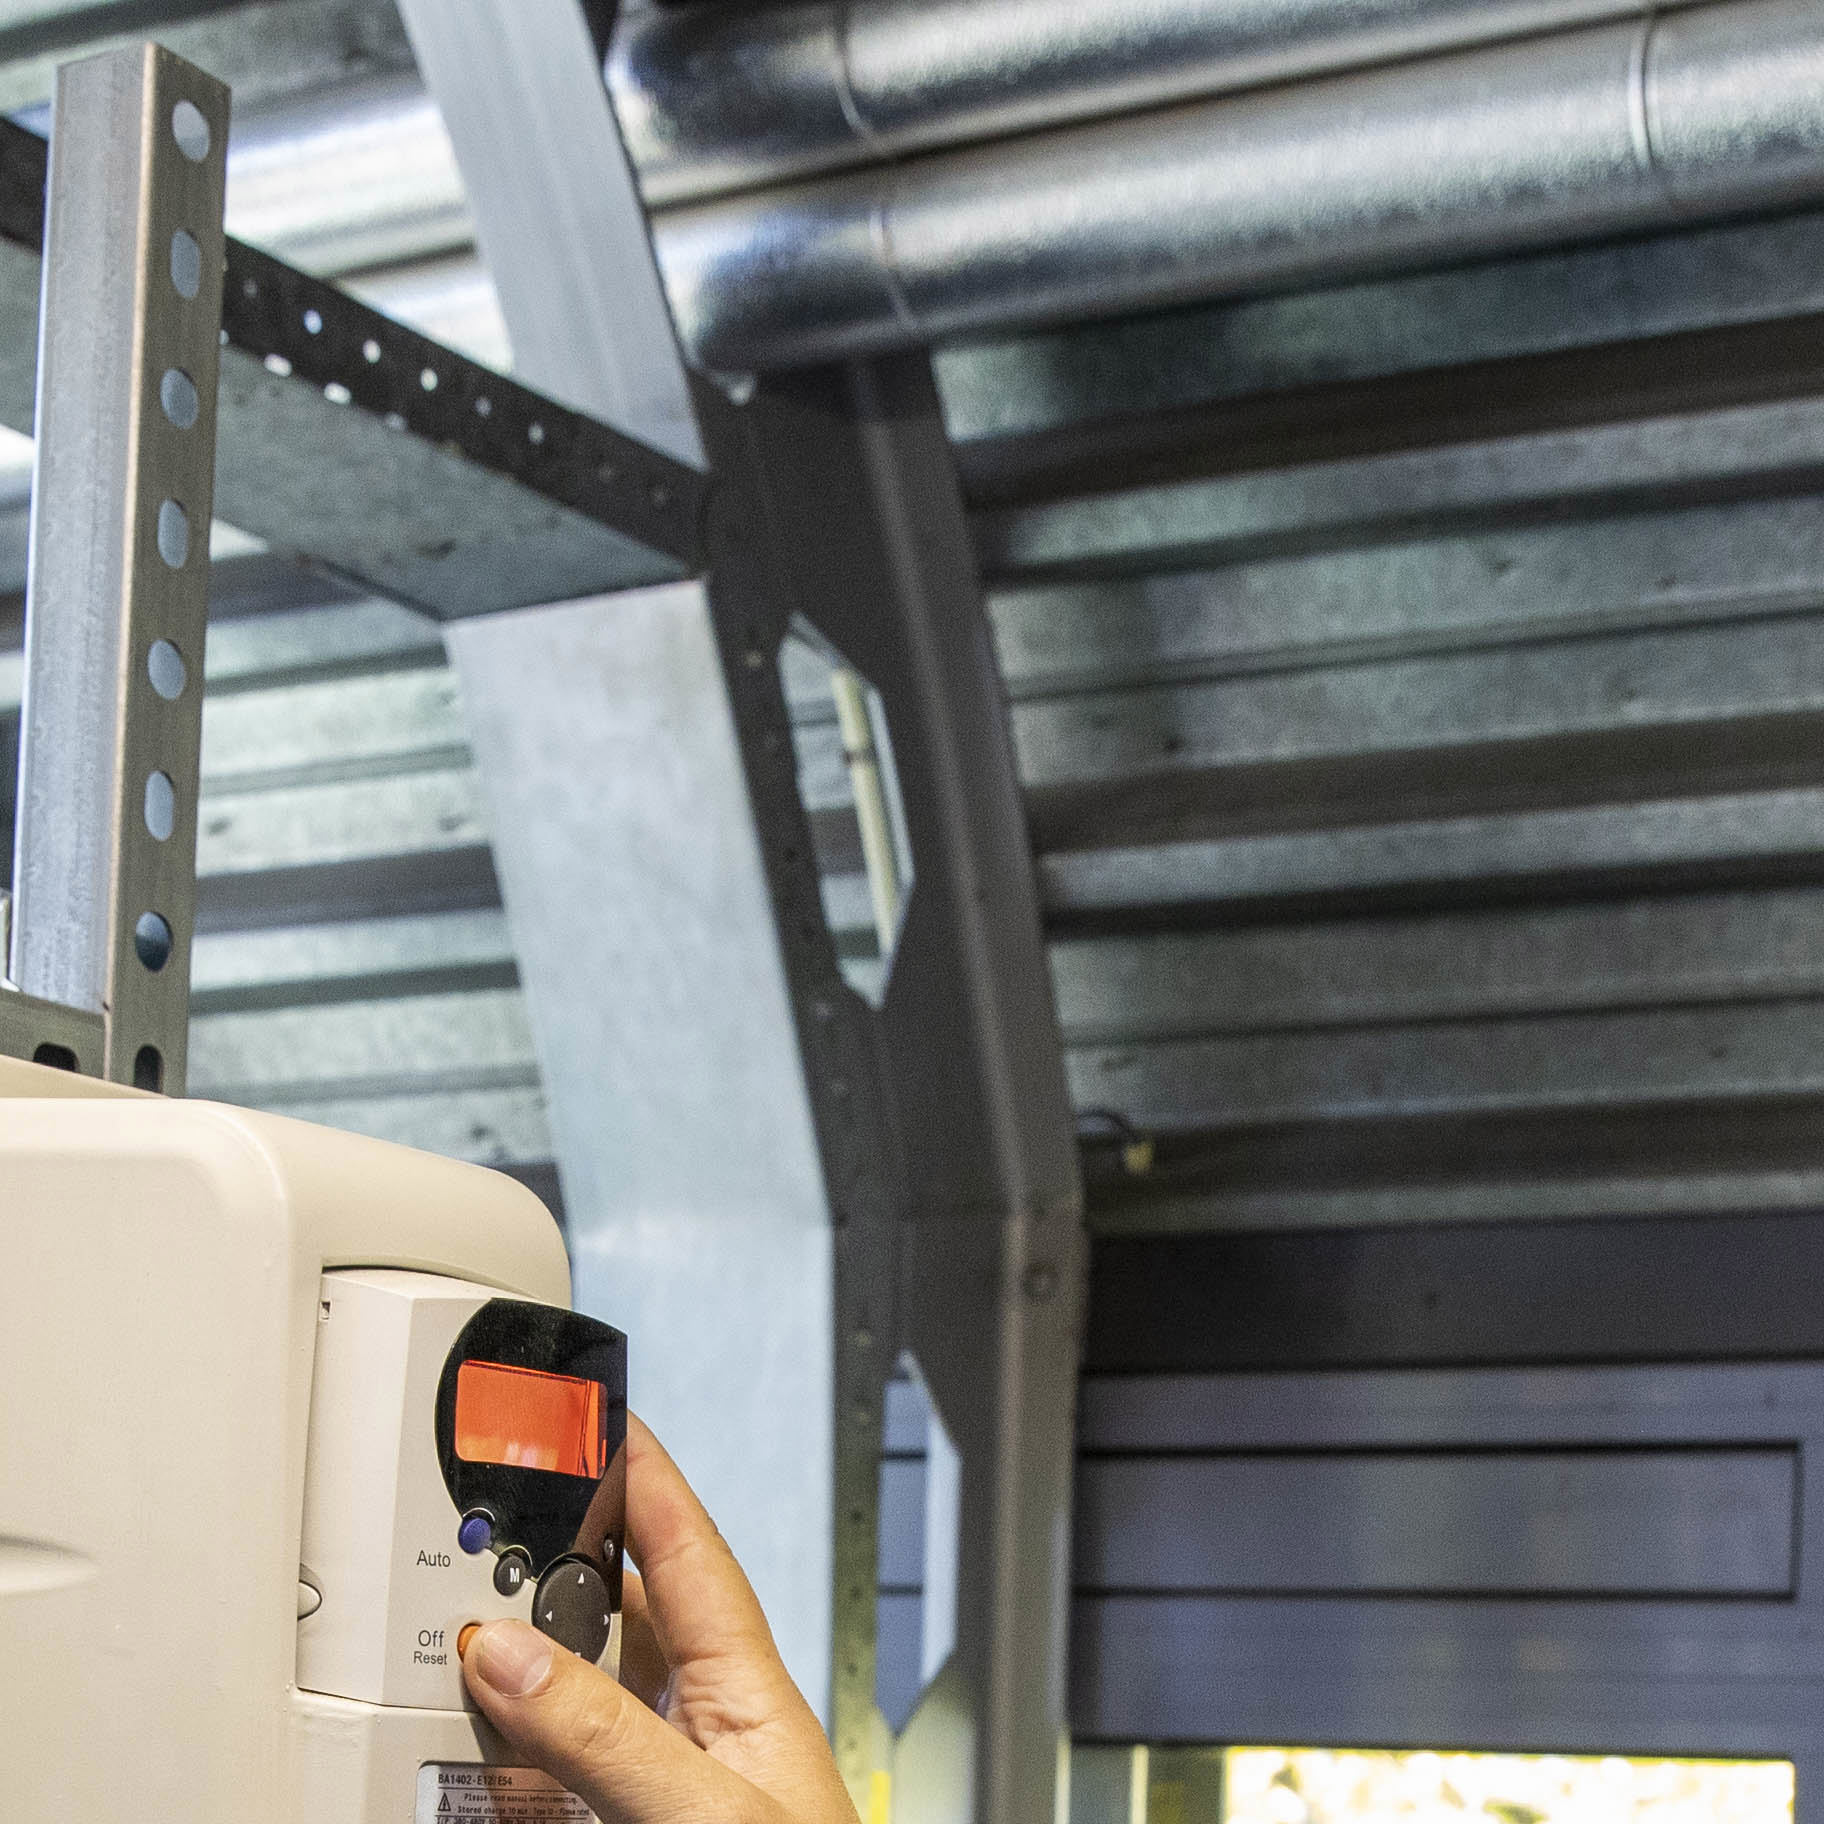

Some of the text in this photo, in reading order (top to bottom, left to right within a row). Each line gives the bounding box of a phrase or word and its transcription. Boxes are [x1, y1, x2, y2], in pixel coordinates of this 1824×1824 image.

[416, 1550, 451, 1568] Auto
[509, 1567, 520, 1583] M
[418, 1630, 445, 1648] Off
[413, 1651, 448, 1666] Reset
[464, 1792, 488, 1802] Please
[457, 1805, 482, 1814] Stored
